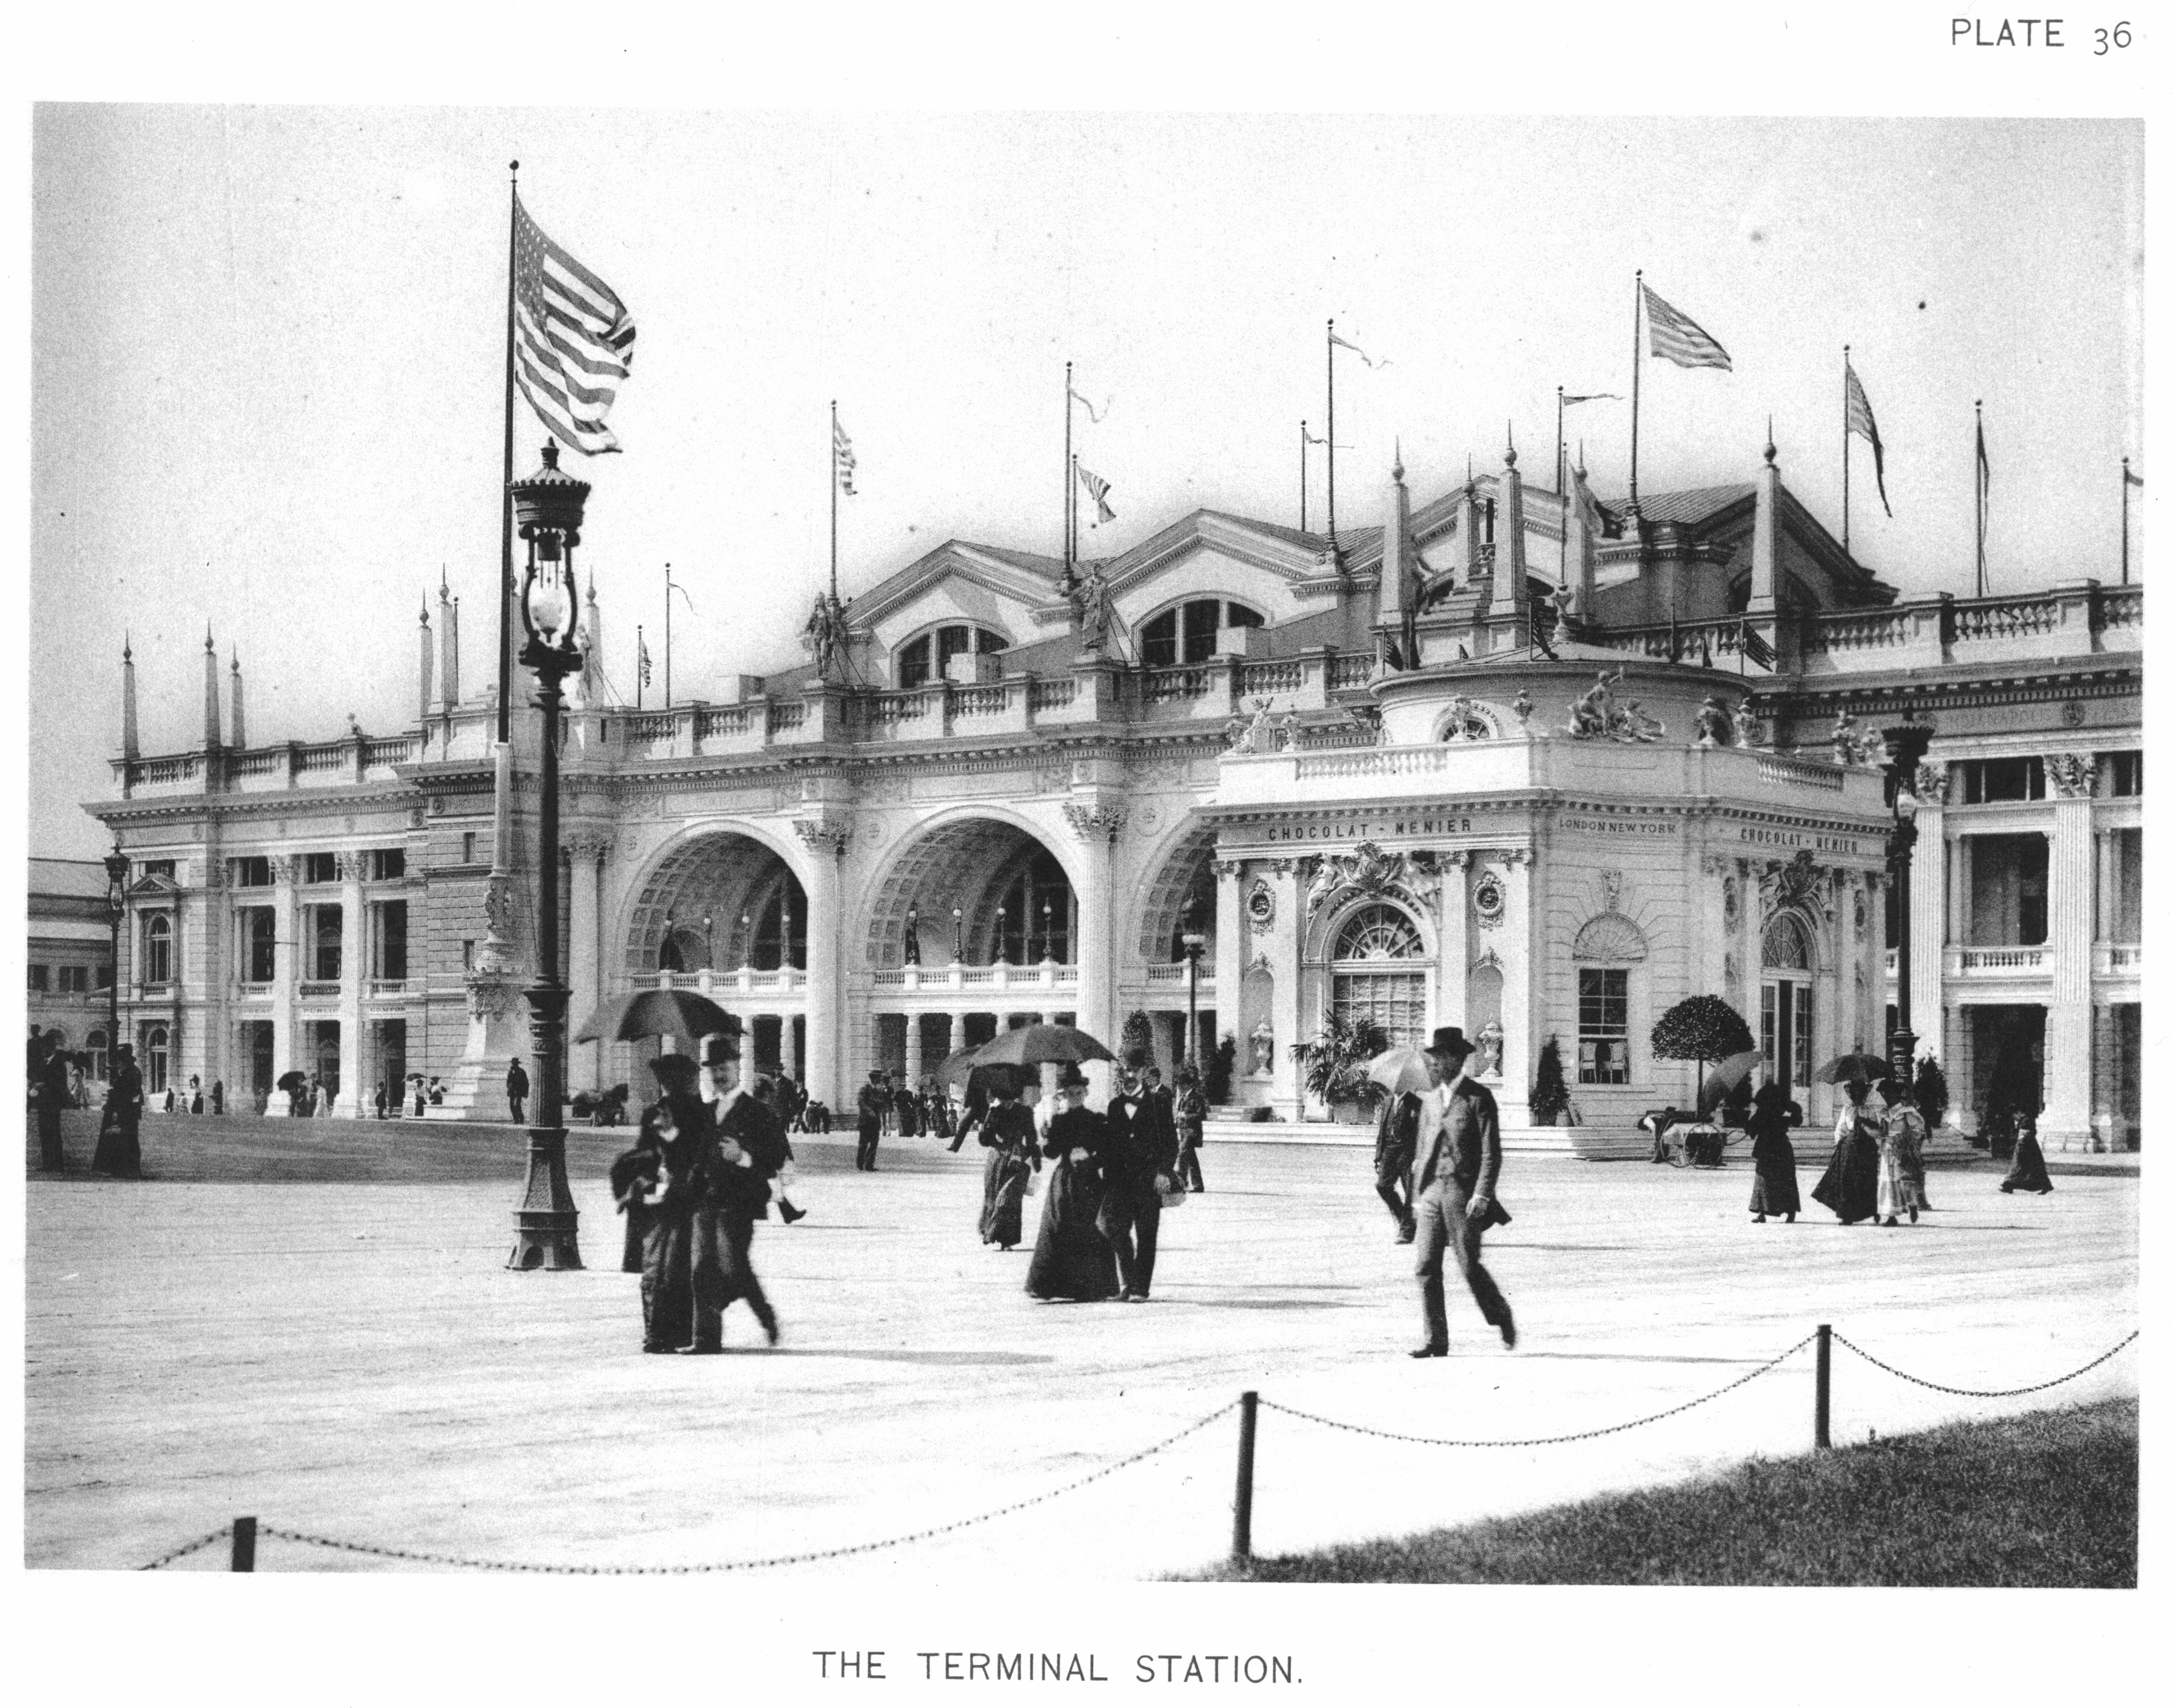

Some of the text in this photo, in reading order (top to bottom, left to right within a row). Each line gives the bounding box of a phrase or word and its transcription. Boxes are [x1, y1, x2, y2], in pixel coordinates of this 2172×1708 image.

[1268, 824, 1368, 841] CHOCOLAT
[1396, 819, 1470, 834] MENIER
[1559, 819, 1676, 833] LONDON NEW YORK
[1741, 828, 1802, 846] CHOCOLAT
[1817, 837, 1858, 855] MENIER
